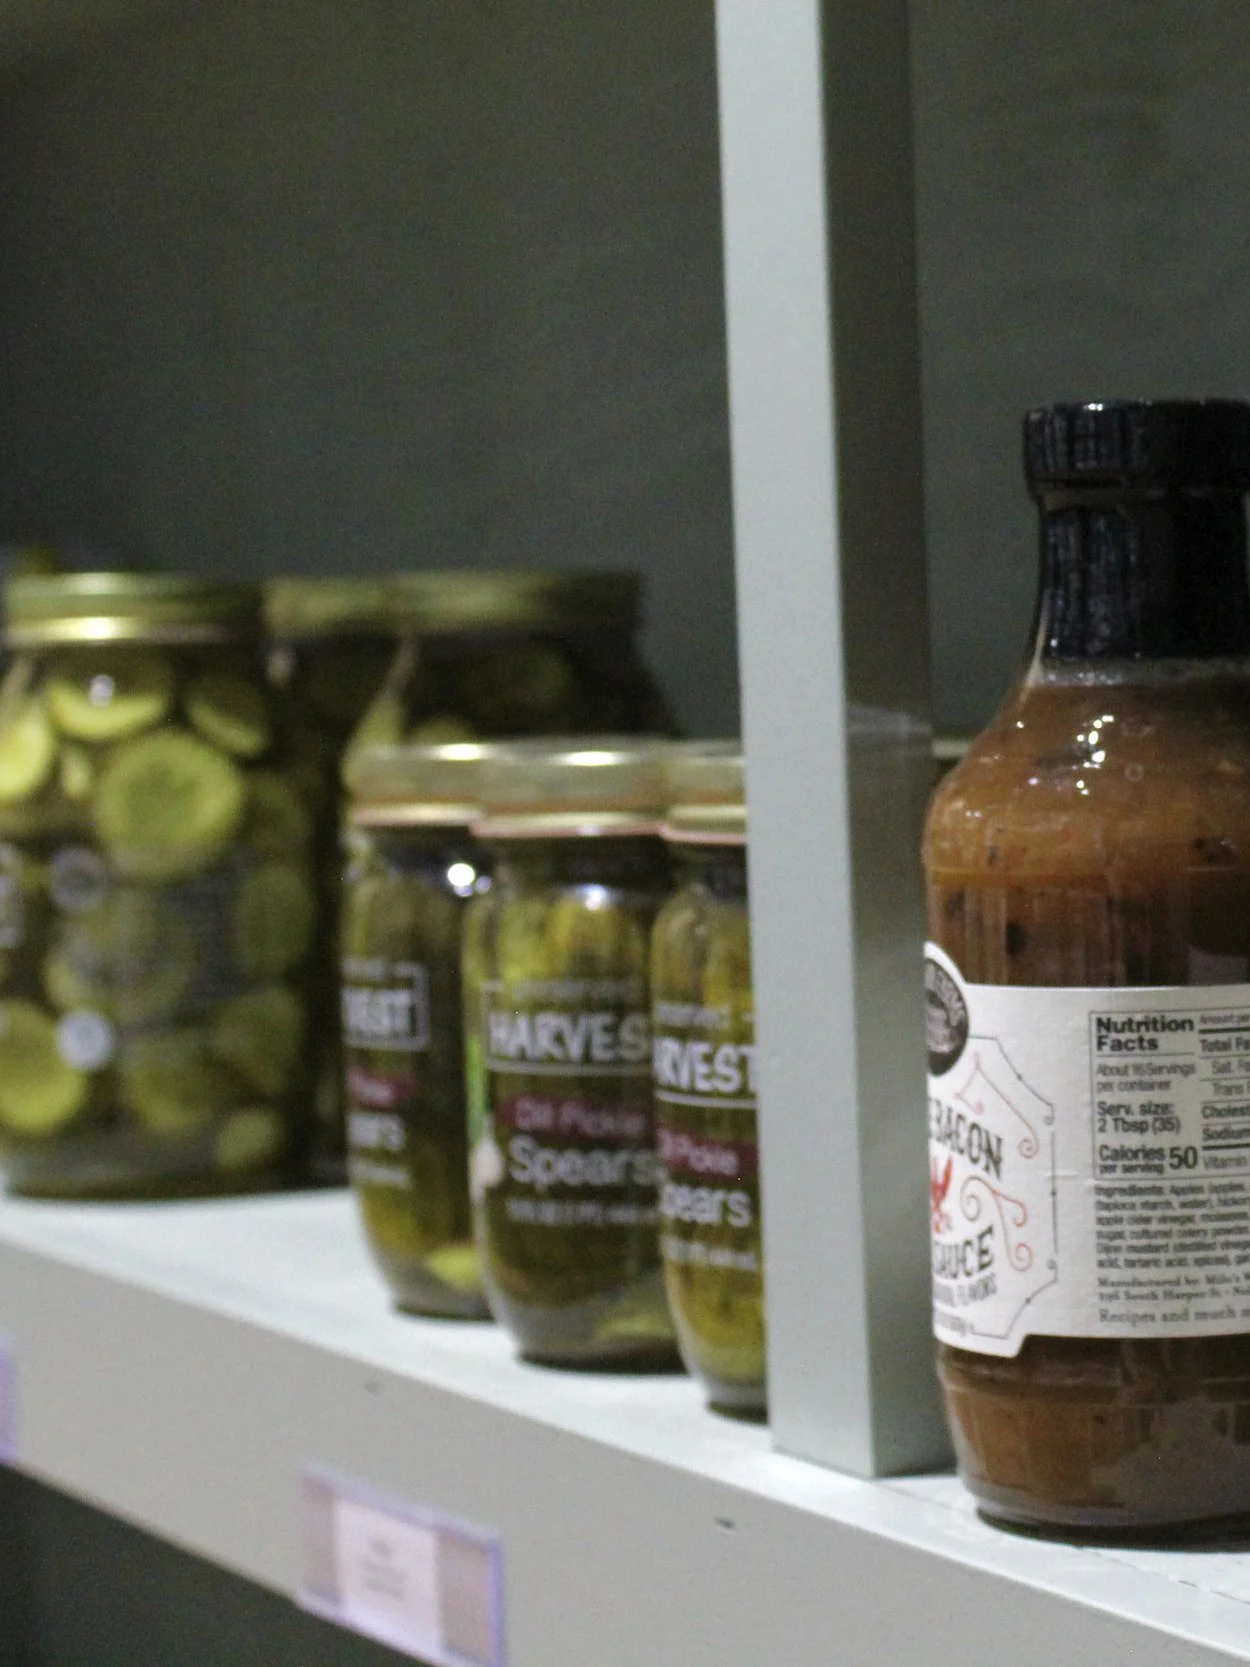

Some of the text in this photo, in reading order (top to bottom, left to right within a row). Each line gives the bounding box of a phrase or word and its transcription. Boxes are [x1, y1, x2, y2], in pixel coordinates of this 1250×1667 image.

[1096, 1014, 1194, 1033] Nutrition
[488, 1012, 651, 1063] HARVES
[1096, 1034, 1159, 1052] Facts
[1201, 1037, 1233, 1053] Total
[1096, 1062, 1129, 1077] About
[1117, 1080, 1172, 1093] container
[1213, 1081, 1245, 1097] Trans
[1097, 1117, 1107, 1134] 2
[1112, 1116, 1149, 1135] Tbsp
[1099, 1143, 1199, 1170] Calories 50
[1099, 1163, 1165, 1176] per serving
[1099, 1308, 1156, 1329] Recipes
[1161, 1306, 1190, 1322] and
[1193, 1303, 1237, 1321] much
